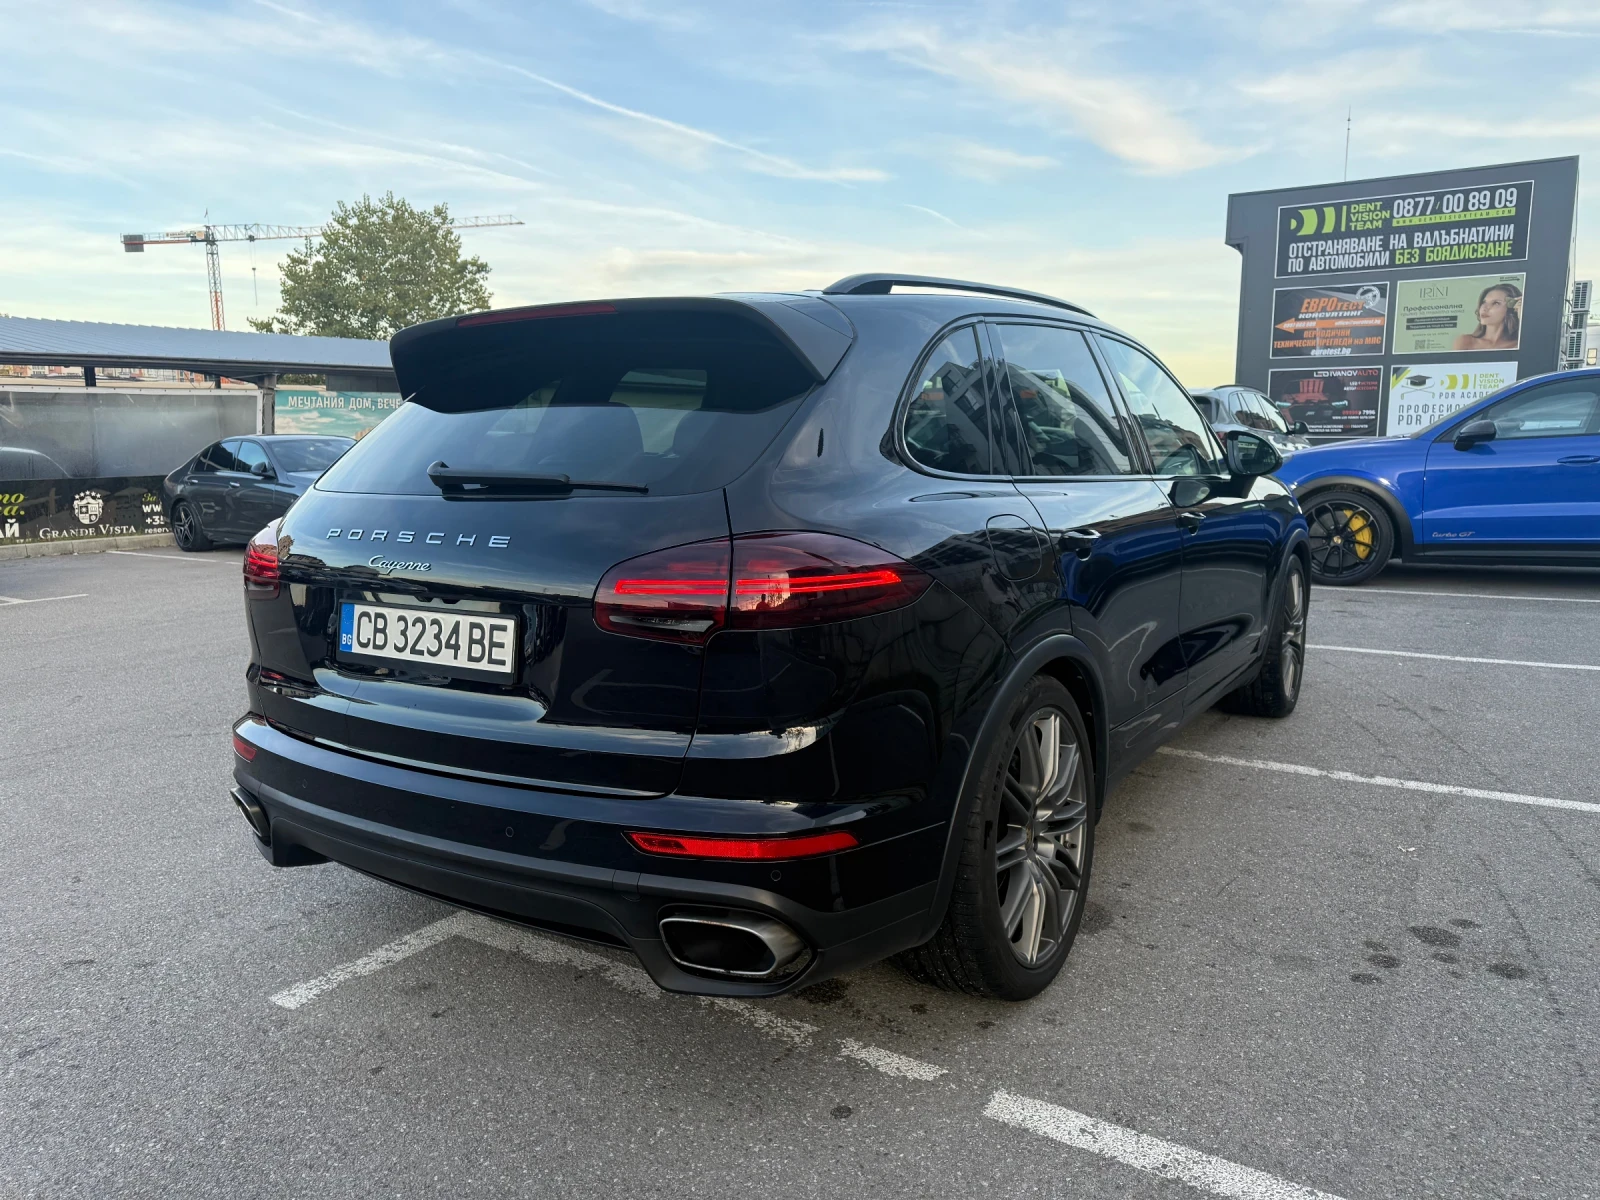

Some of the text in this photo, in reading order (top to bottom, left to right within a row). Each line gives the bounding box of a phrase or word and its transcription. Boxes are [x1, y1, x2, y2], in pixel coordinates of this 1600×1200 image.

[1468, 190, 1490, 211] 89
[1494, 188, 1517, 208] 09
[1350, 202, 1382, 212] DENT
[1350, 210, 1390, 222] VISION
[1396, 209, 1512, 225] WWW.DENTVISIONTEAM.COM
[1350, 220, 1382, 231] TEAM
[1289, 224, 1514, 258] ОТСТРАНЯВАНЕ НА ВДЛЪБНАТИНИ
[1288, 241, 1513, 273] ПО АВТОМОБИЛИ БЕЗ БОЯДИСВАНЕ
[1304, 329, 1351, 338] ПЕРИОДИЧНИ
[1274, 340, 1316, 348] ТЕХНИЧЕСКИ
[1364, 336, 1382, 345] МПС
[288, 396, 344, 409] МЕЧТАНИЯ
[349, 397, 375, 411] ДОМ,
[1398, 403, 1465, 414] ПРОФЕСИО
[1398, 414, 1422, 426] PDR
[99, 524, 137, 535] VISTA
[326, 528, 511, 548] PORSCHE
[368, 554, 432, 576] Cayenne
[342, 633, 352, 645] BG
[356, 610, 508, 666] CB 3234 BE
